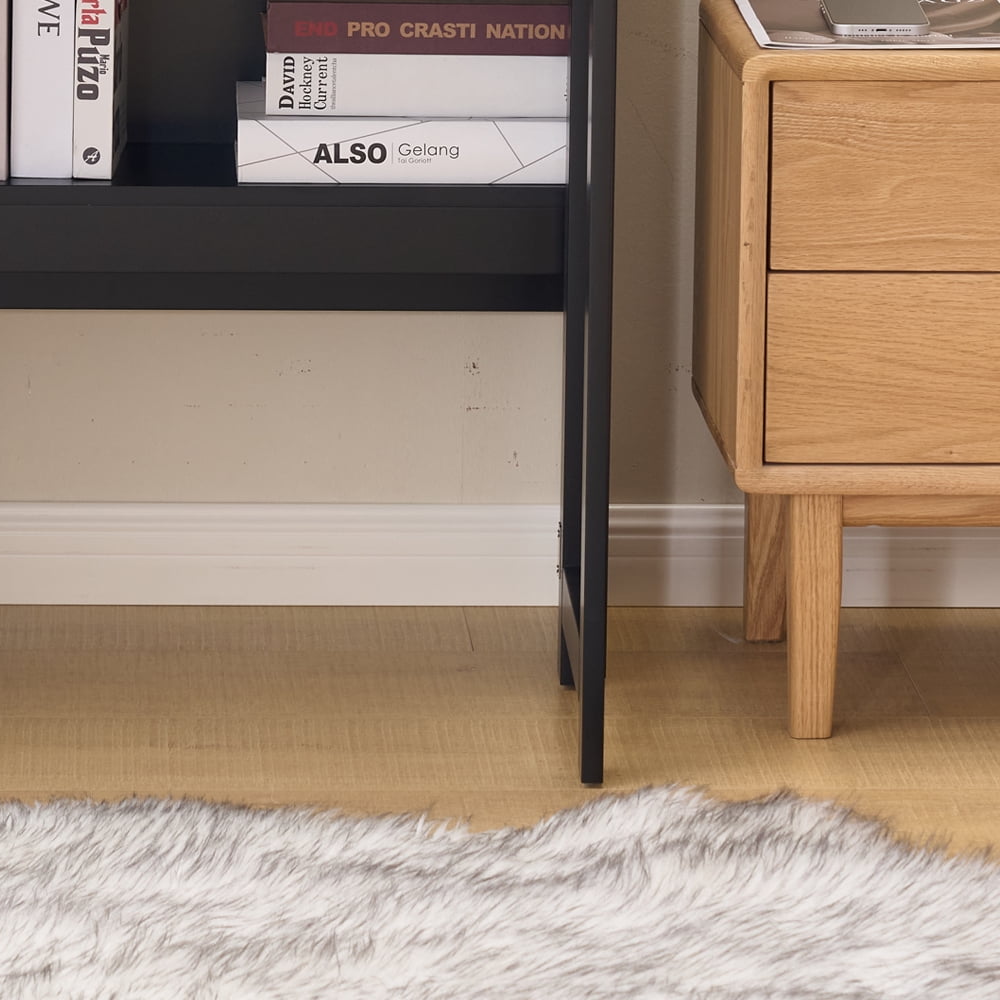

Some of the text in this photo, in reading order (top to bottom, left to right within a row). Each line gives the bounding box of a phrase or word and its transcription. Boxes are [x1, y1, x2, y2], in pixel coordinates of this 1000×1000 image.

[295, 21, 565, 39] END PRO CRASTI NATION
[77, 27, 111, 101] Mario Puzo
[278, 56, 295, 110] DAVID
[298, 56, 315, 110] Hockney
[313, 56, 328, 110] Current
[313, 143, 387, 164] ALSO
[398, 143, 460, 159] Gelang
